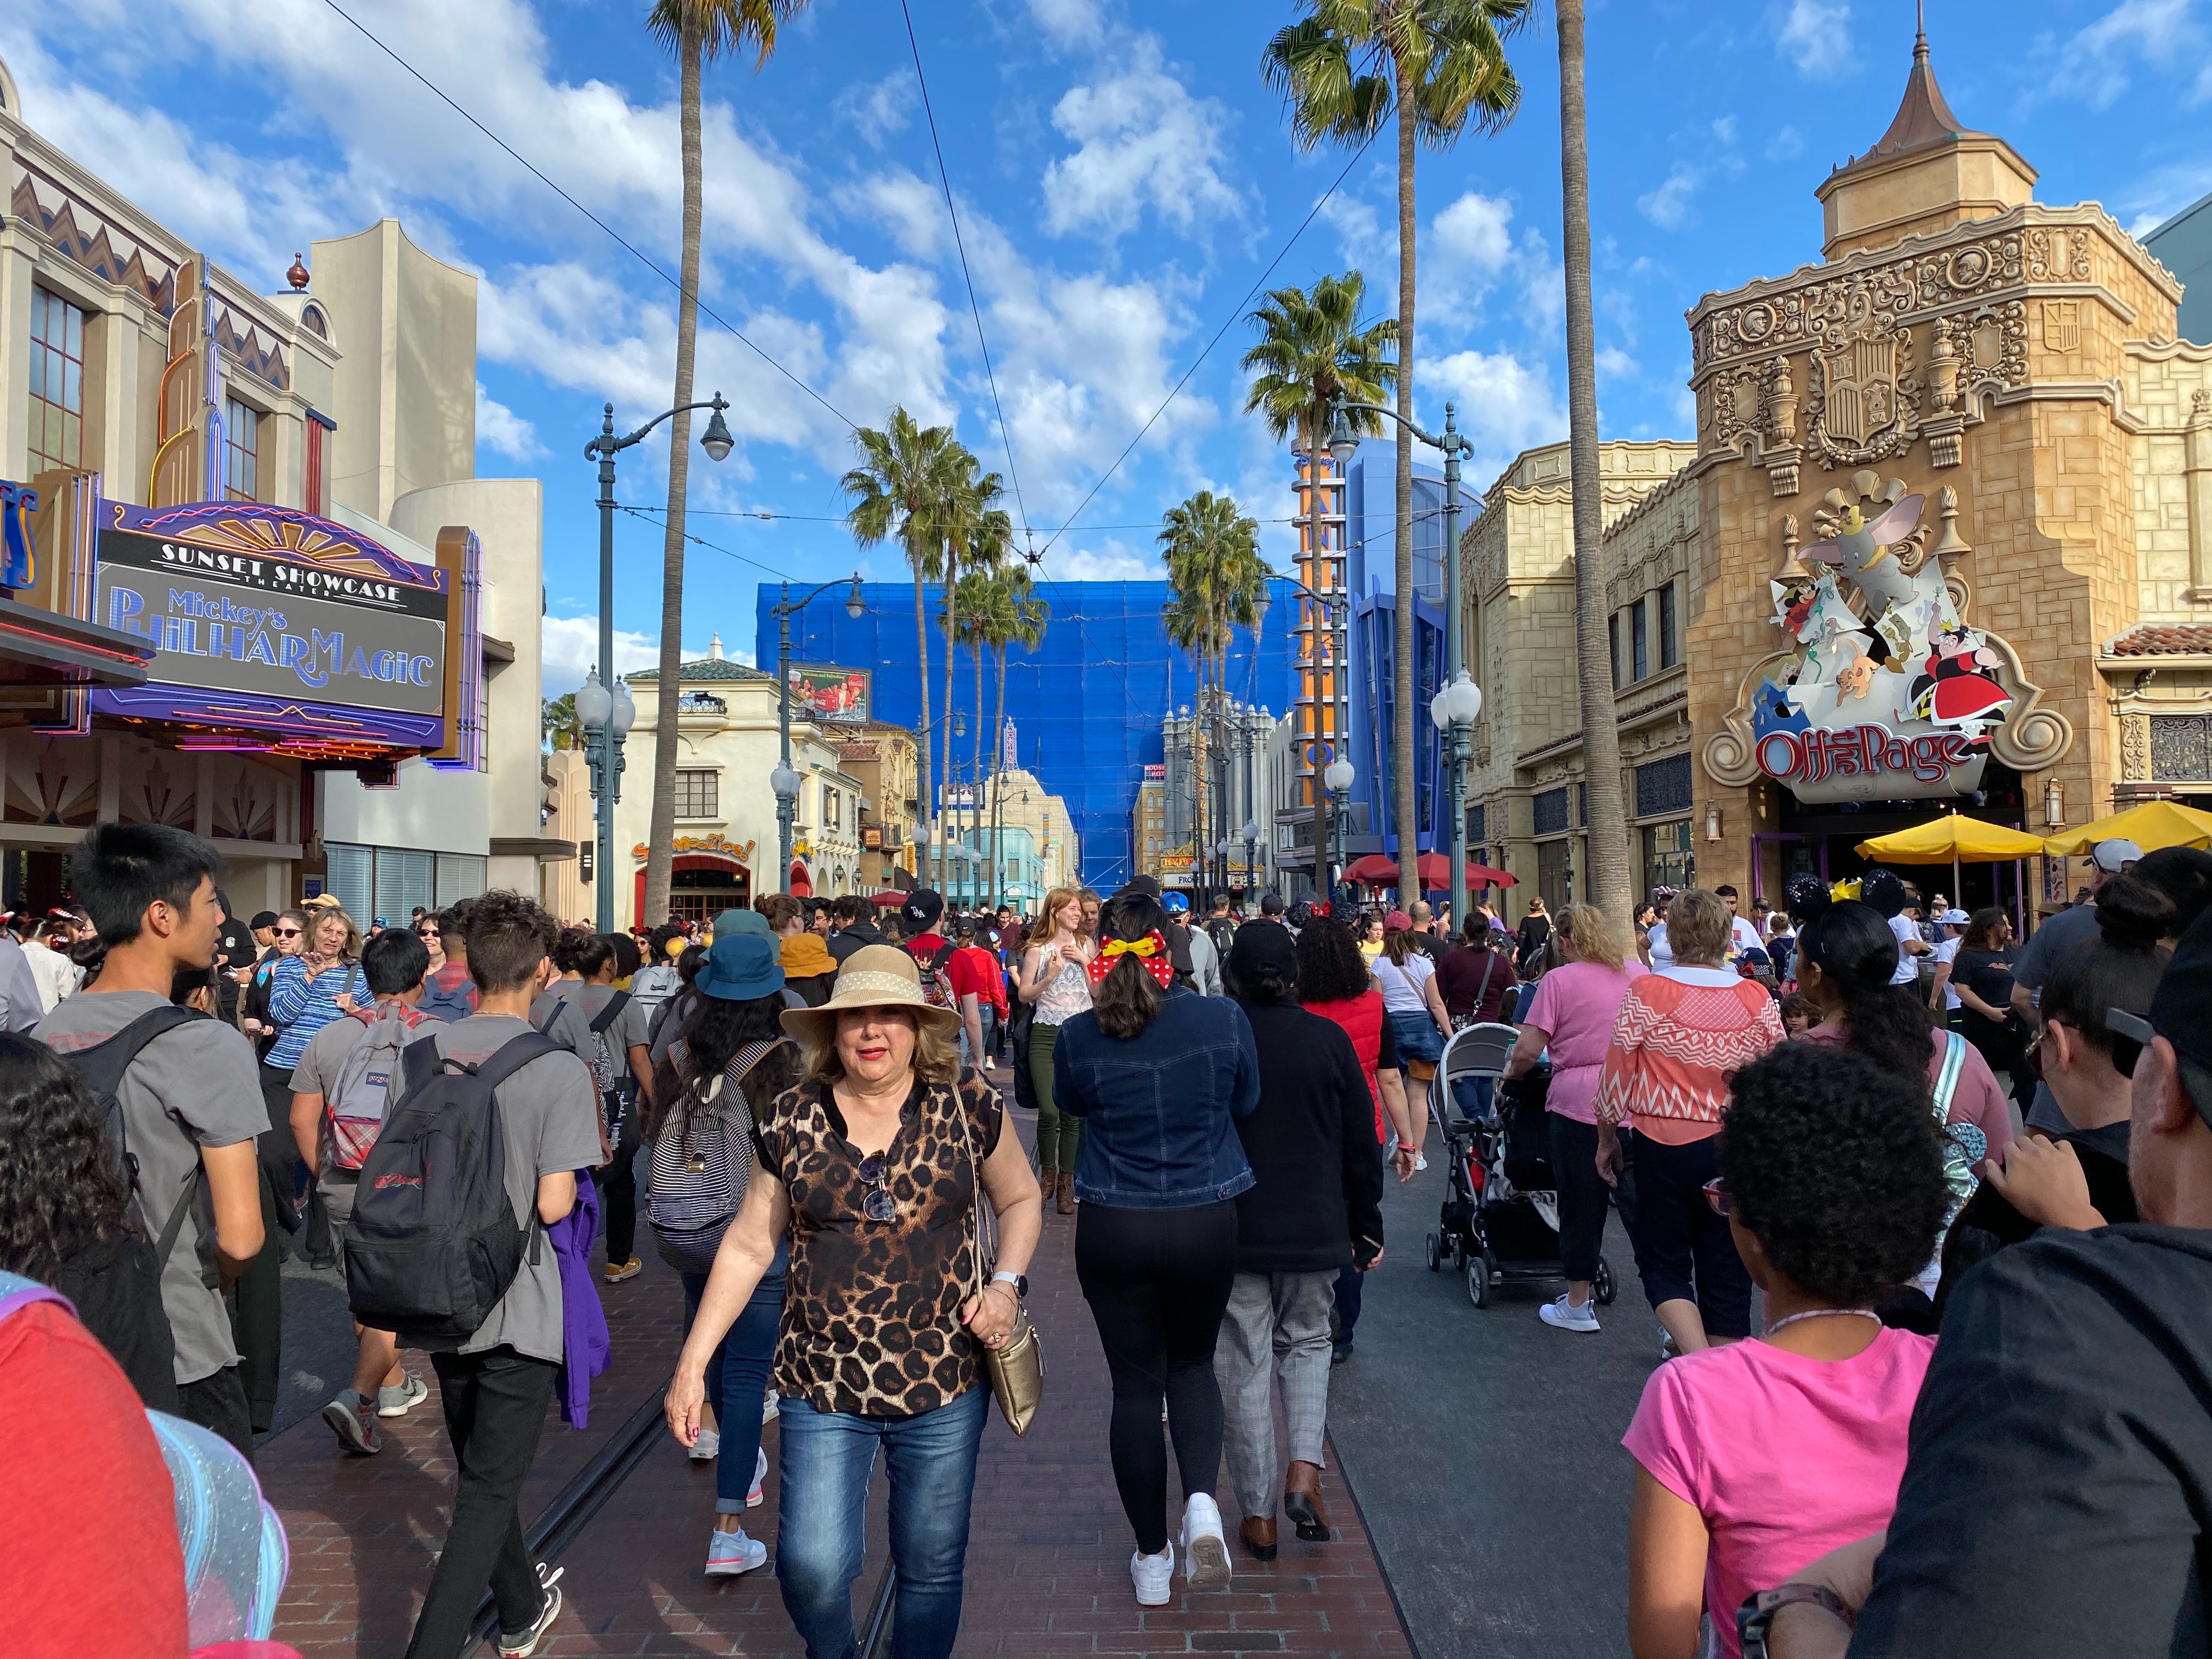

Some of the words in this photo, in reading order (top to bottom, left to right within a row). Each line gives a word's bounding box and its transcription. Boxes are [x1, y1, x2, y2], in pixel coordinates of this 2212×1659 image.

[161, 543, 263, 577] SUNSET
[275, 565, 401, 602] SHOWCASE
[245, 575, 330, 597] THEATER
[168, 588, 288, 641] Mickey's
[1756, 727, 1834, 784] Off
[1854, 722, 1973, 785] Page
